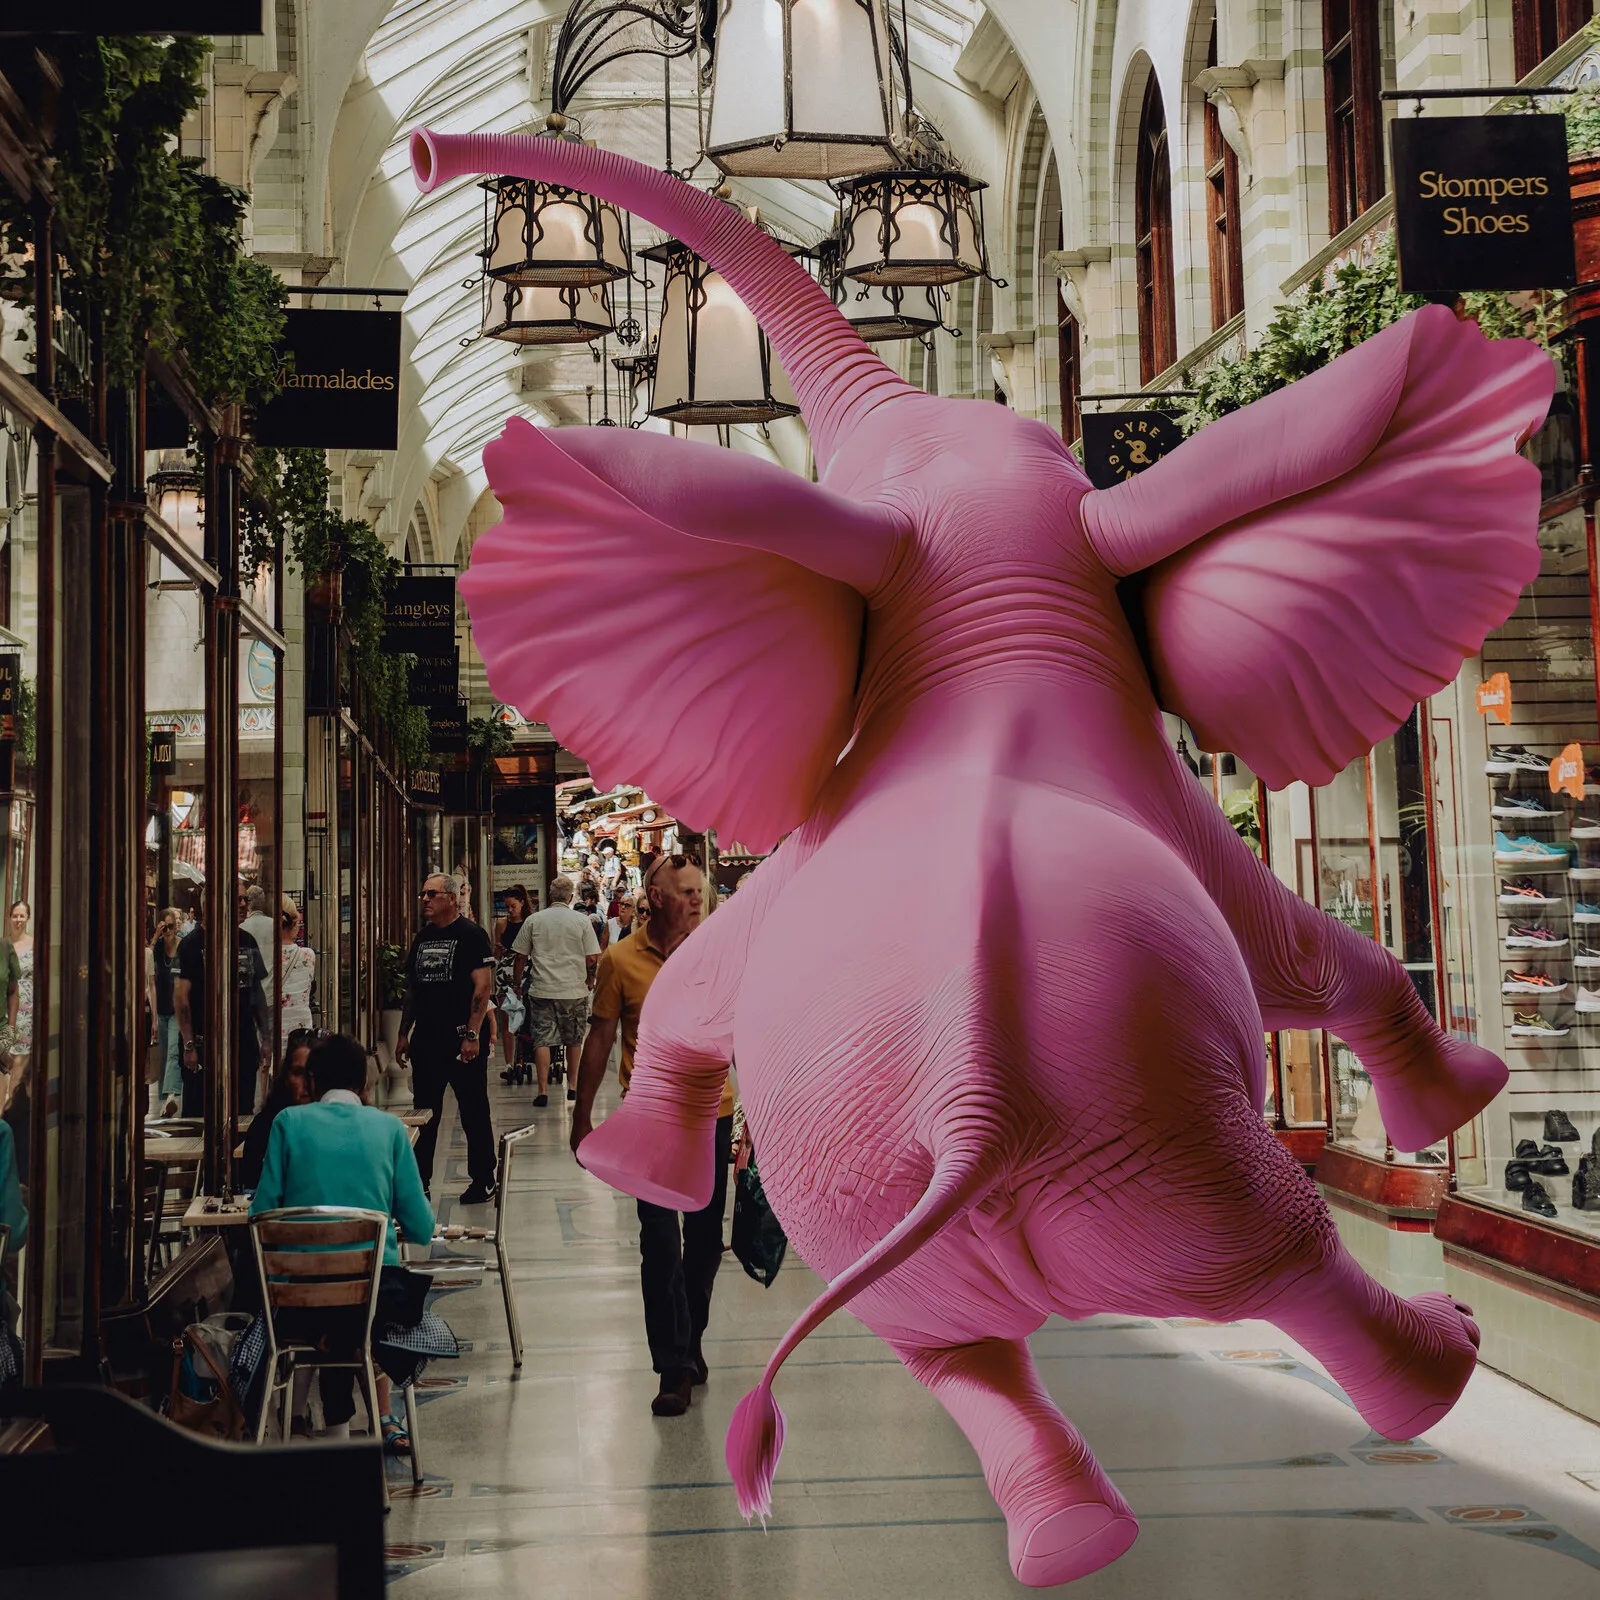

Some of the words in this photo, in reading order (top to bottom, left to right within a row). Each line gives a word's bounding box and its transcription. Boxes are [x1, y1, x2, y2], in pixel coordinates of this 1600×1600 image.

[1418, 170, 1550, 205] Stompers
[1442, 207, 1531, 235] Shoes
[1113, 420, 1161, 441] GYRE
[382, 599, 450, 619] Langleys
[418, 656, 452, 667] OWERS
[430, 719, 461, 729] angleys
[501, 868, 517, 876] Royal
